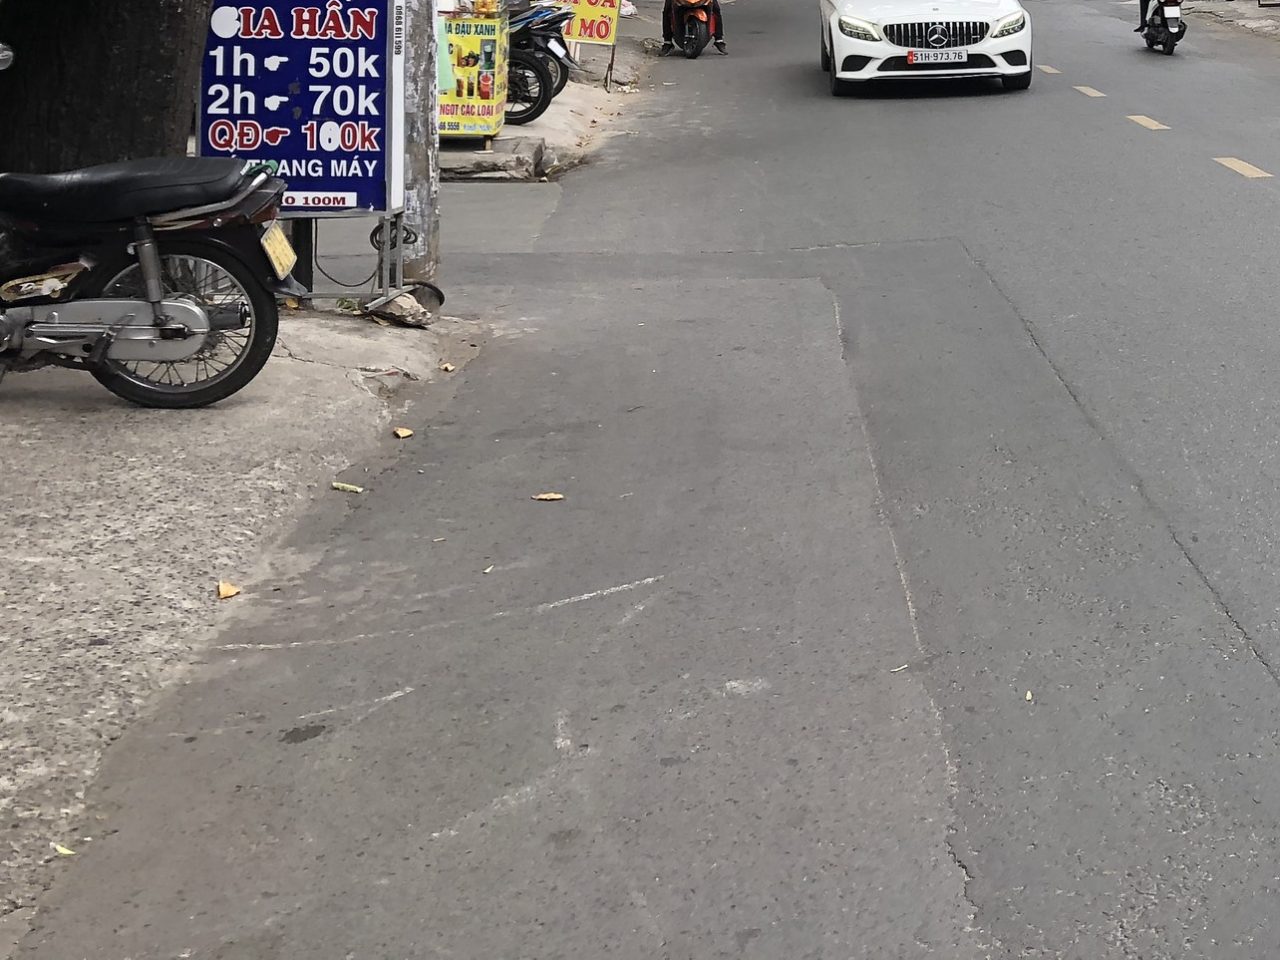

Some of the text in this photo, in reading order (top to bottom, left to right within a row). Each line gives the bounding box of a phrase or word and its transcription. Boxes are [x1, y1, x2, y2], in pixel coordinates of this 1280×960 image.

[473, 24, 496, 37] XANH
[578, 14, 613, 39] MỠ
[208, 45, 380, 78] 1h 50k
[207, 83, 380, 116] 2h 70k
[439, 102, 494, 118] NGỌT CÁC LOẠI
[208, 119, 263, 153] QĐ
[330, 155, 378, 178] MÁY
[302, 195, 347, 206] 100M
